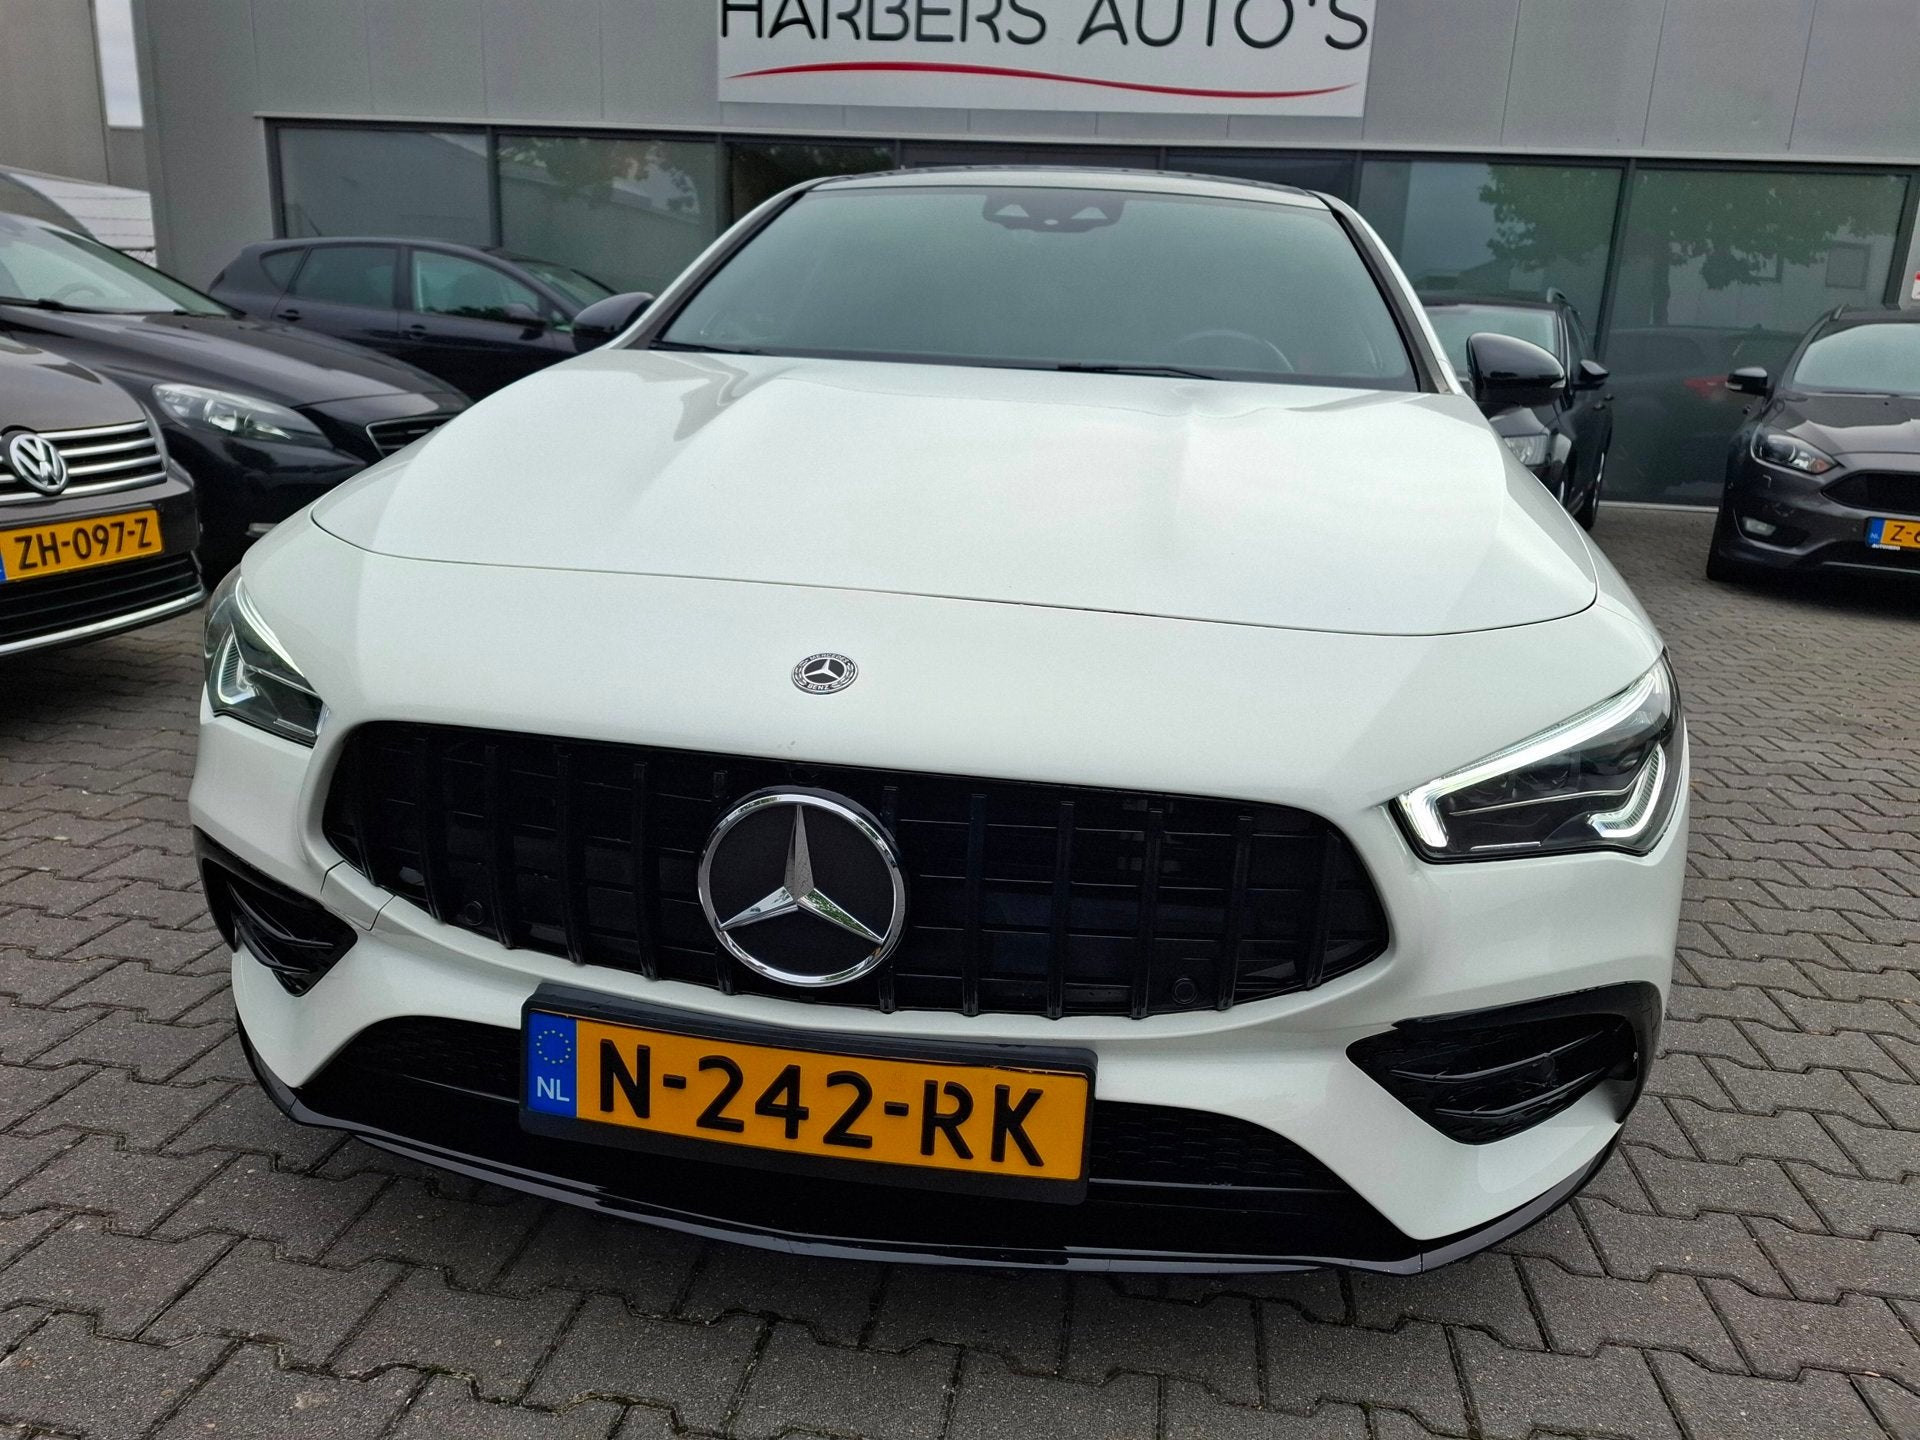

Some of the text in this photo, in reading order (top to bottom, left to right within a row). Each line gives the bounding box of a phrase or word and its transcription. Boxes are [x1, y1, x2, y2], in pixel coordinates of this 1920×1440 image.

[722, 0, 1046, 45] HARBERS
[14, 517, 152, 570] ZH-097-Z
[807, 683, 831, 691] BENZ
[537, 1075, 570, 1102] NL
[599, 1038, 1044, 1168] N-242-RK
